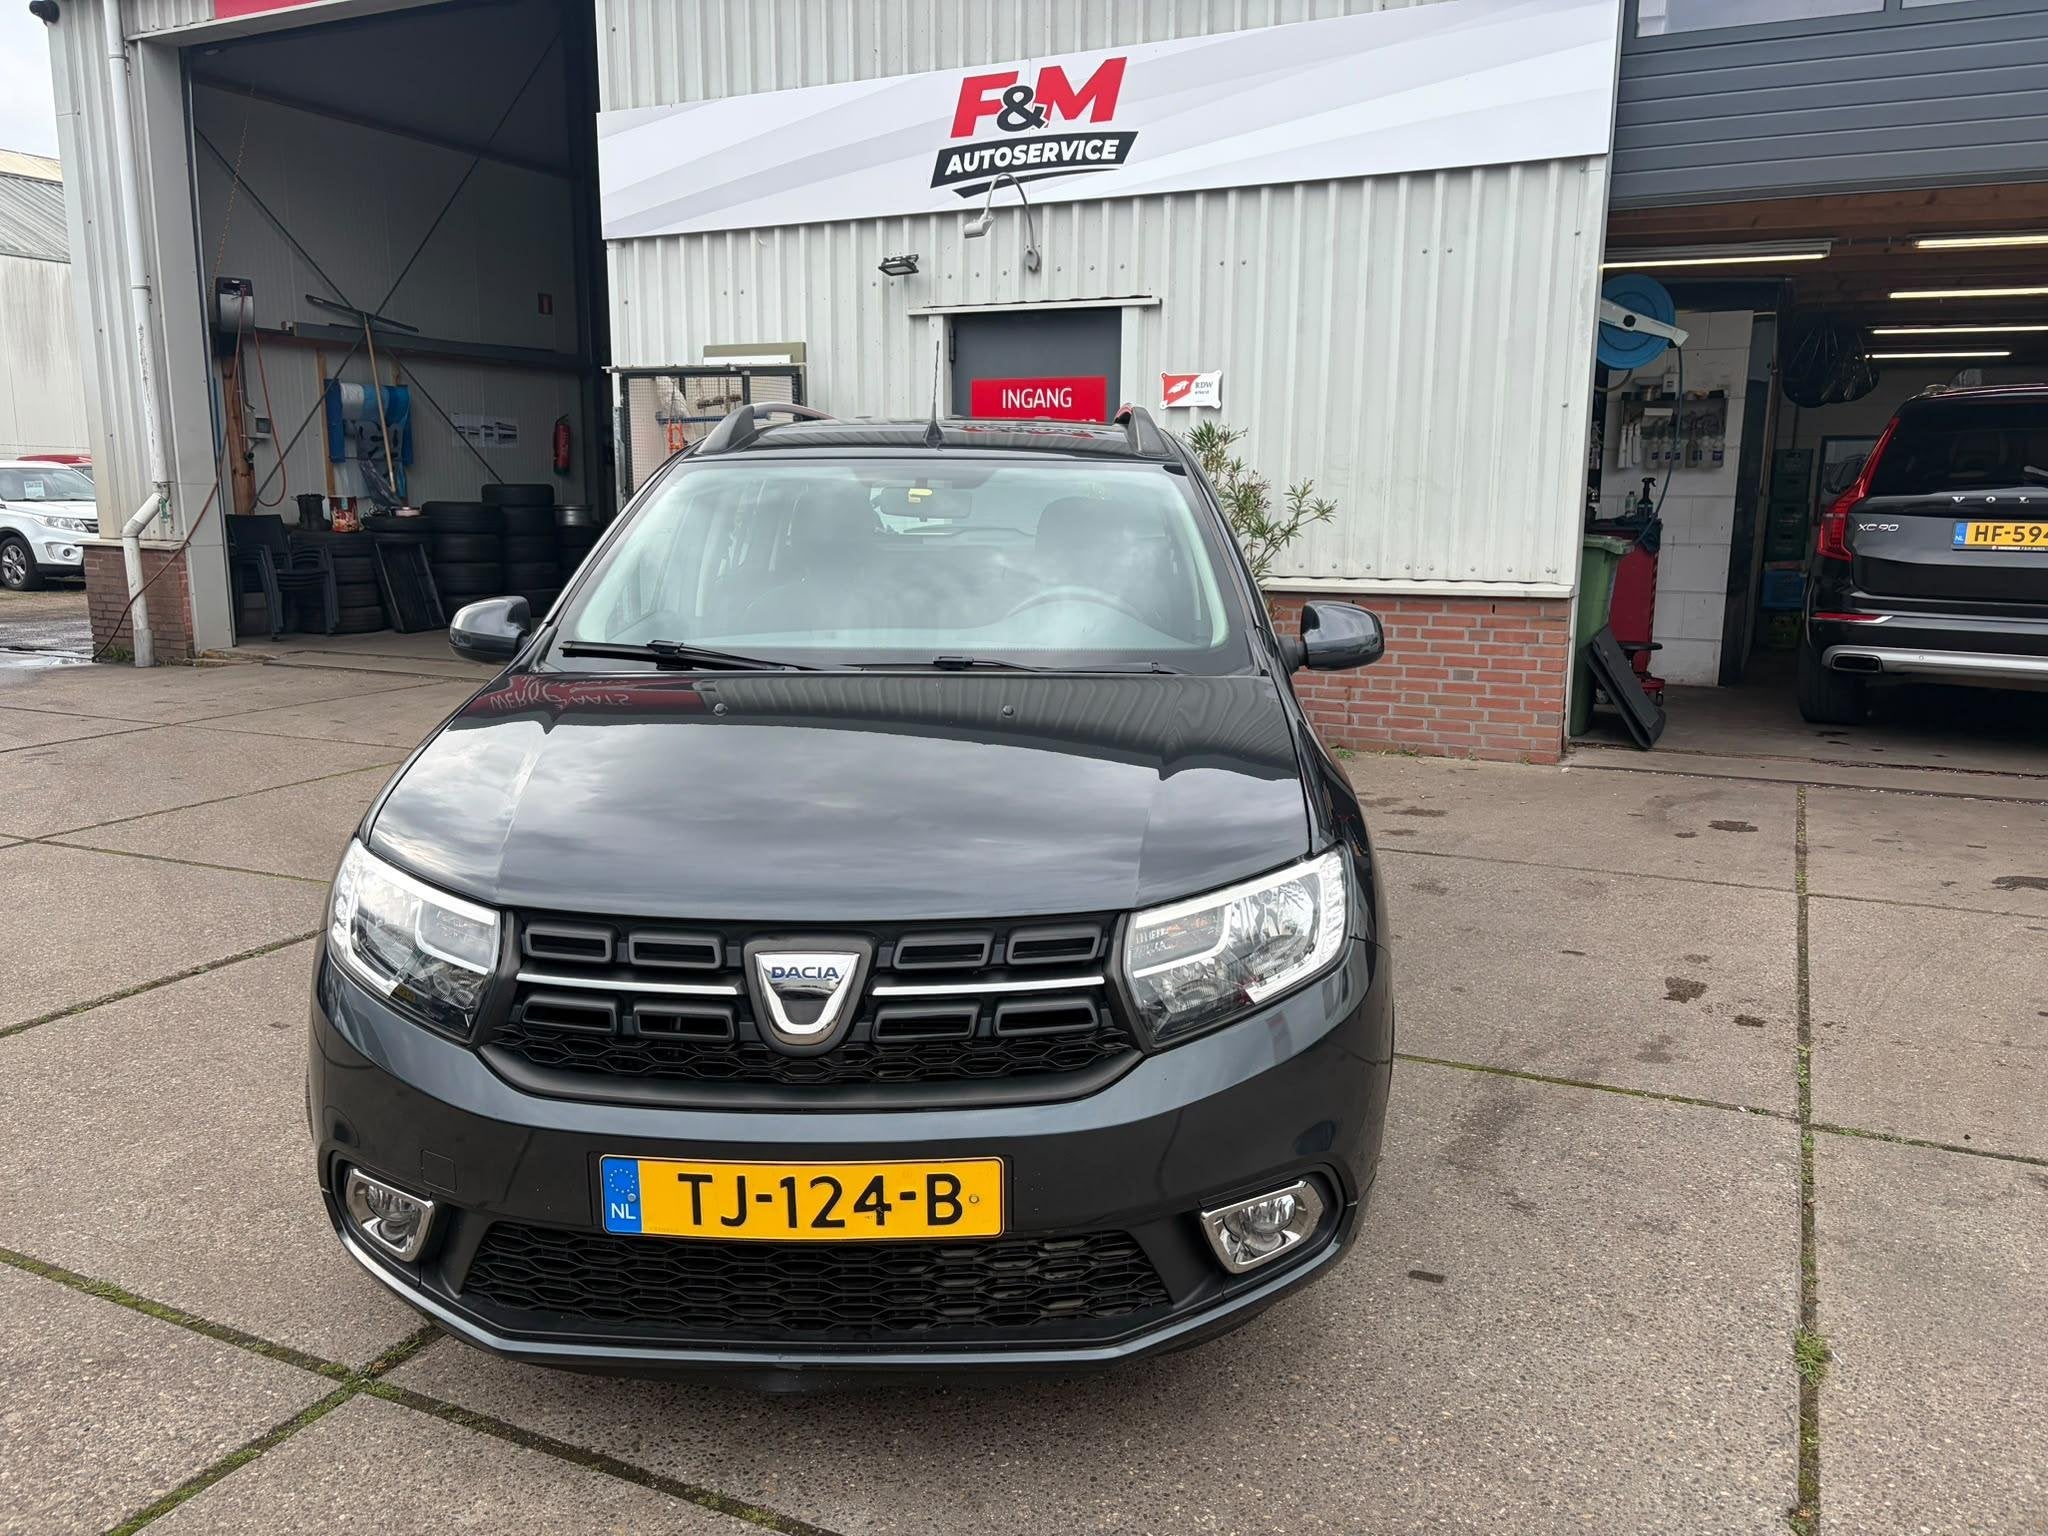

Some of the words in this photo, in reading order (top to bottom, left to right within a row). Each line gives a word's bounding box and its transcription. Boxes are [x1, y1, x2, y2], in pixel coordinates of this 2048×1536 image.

[951, 57, 1127, 138] F&M
[945, 140, 1120, 176] AUTOSERVICE
[1002, 388, 1072, 409] INGANG
[771, 966, 839, 978] DACIA
[611, 1202, 636, 1220] NL
[677, 1172, 963, 1228] TJ-124-B
